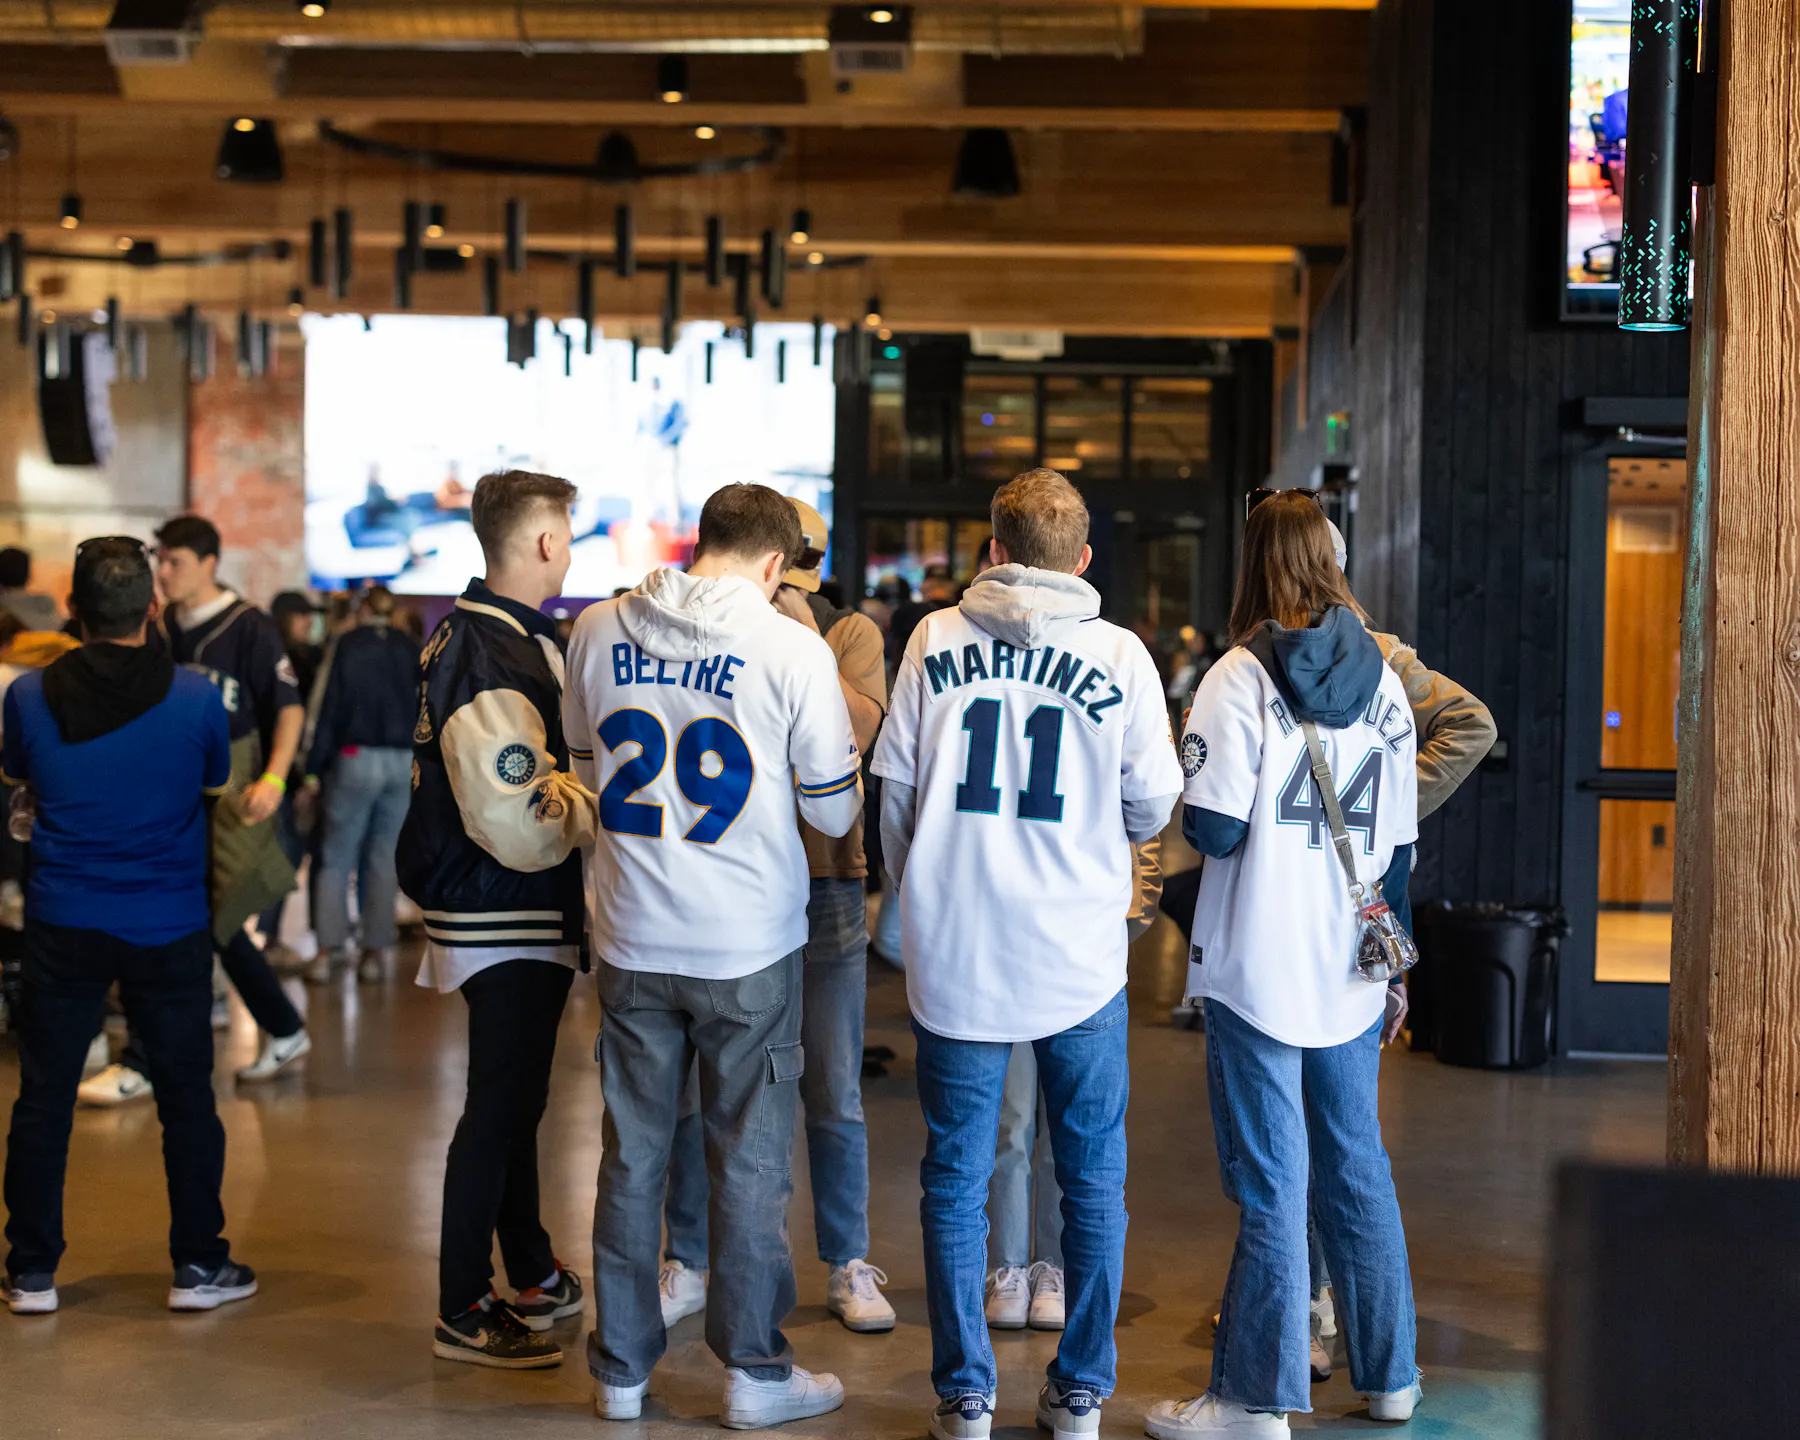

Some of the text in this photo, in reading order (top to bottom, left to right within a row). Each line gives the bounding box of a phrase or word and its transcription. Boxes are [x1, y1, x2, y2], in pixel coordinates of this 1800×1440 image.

[924, 640, 1123, 724] MARTINEZ
[597, 706, 755, 845] 29
[956, 697, 1065, 822] 11
[1276, 740, 1385, 856] 44
[961, 1401, 983, 1412] NIKE
[1069, 1396, 1091, 1408] NIKE
